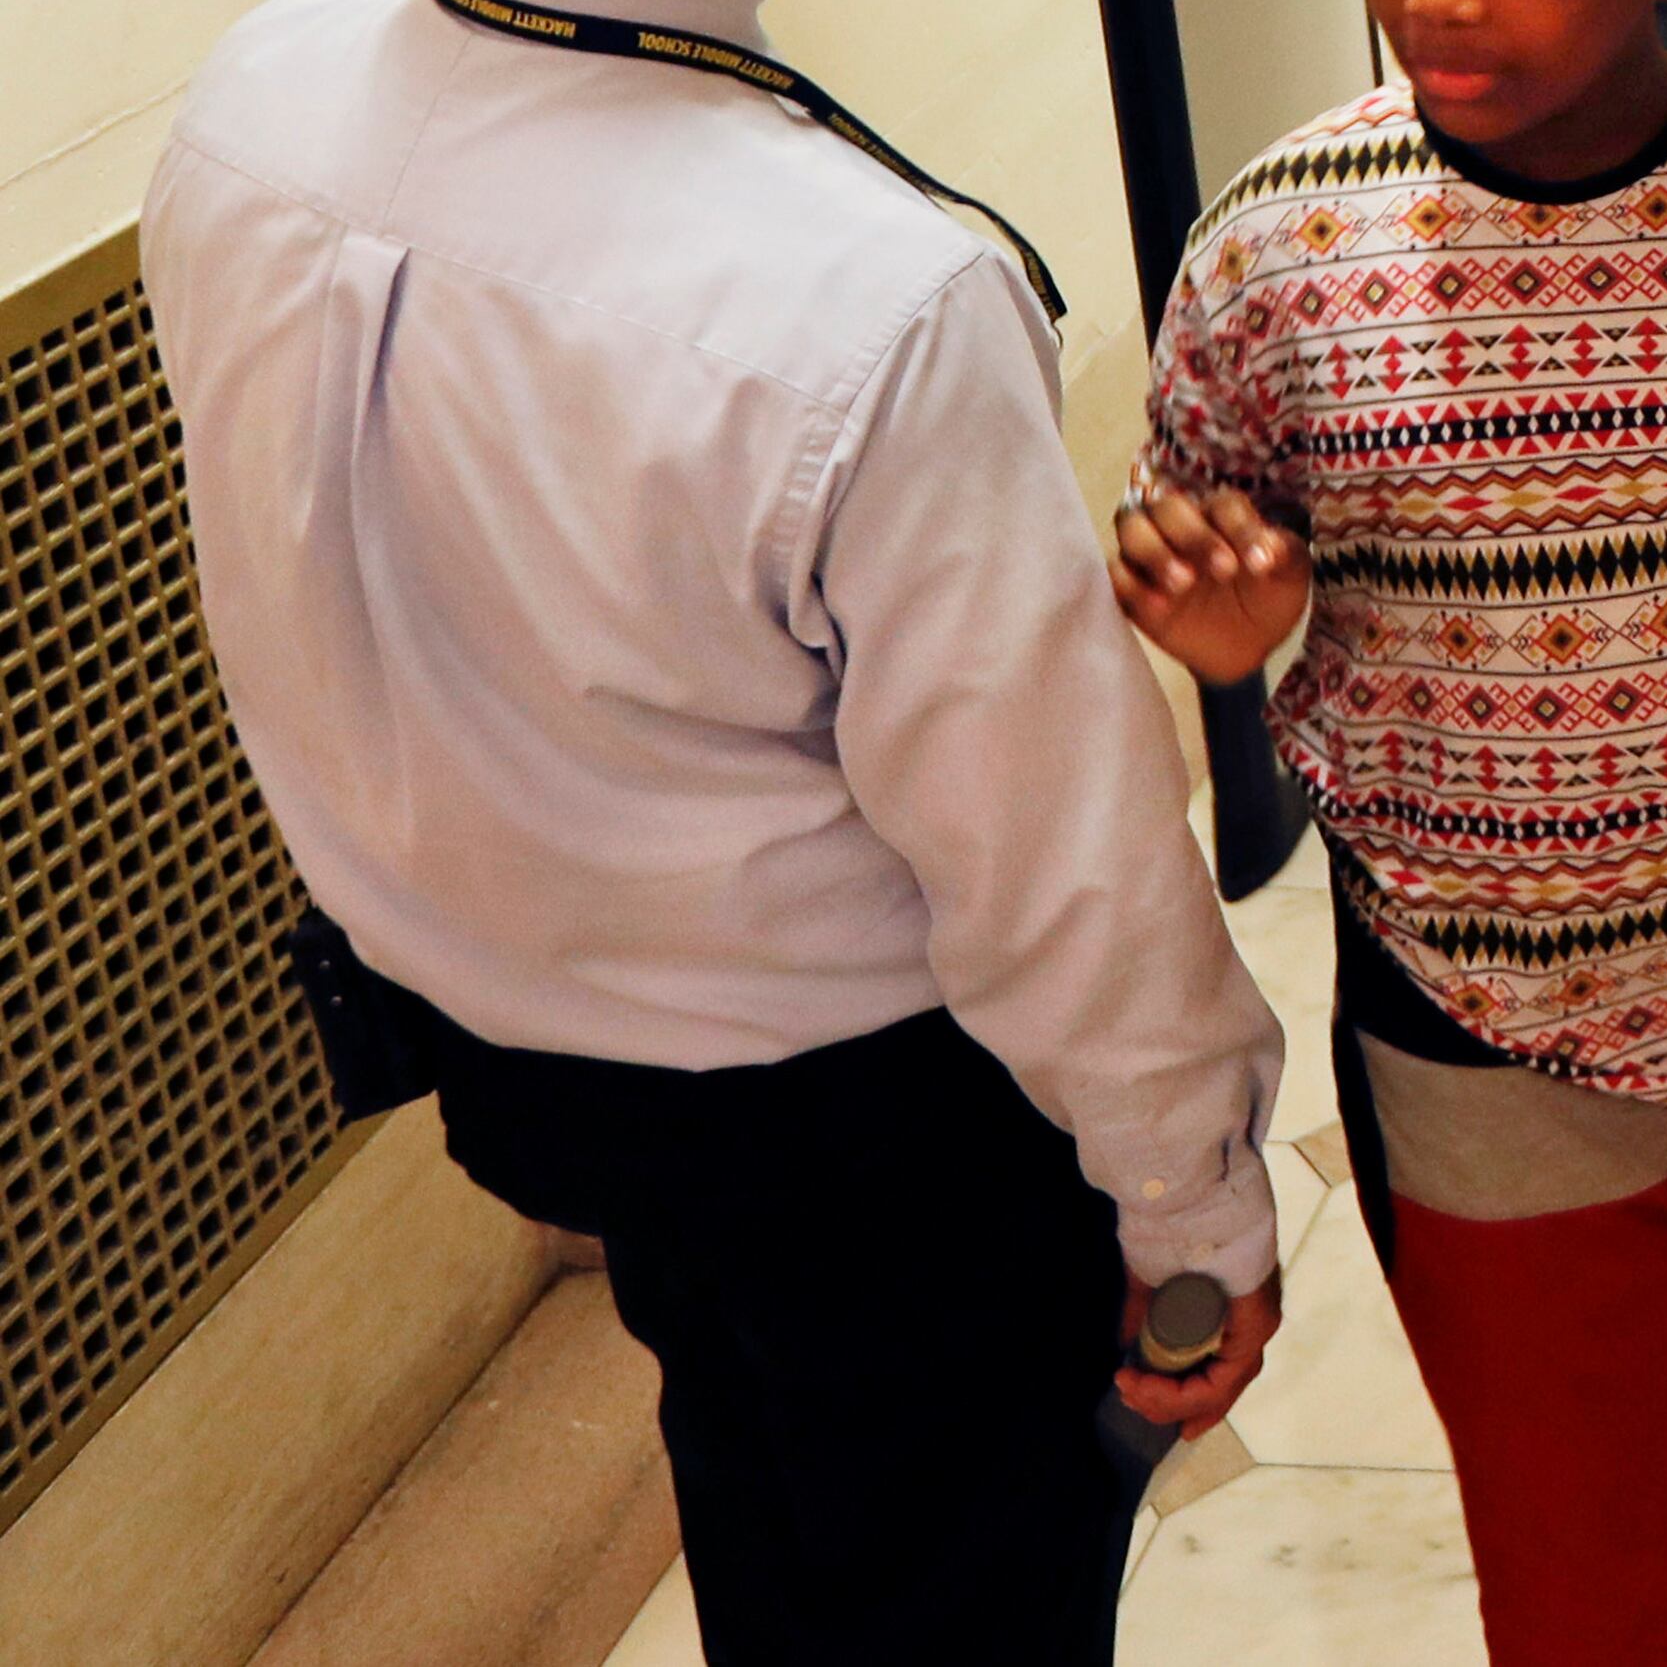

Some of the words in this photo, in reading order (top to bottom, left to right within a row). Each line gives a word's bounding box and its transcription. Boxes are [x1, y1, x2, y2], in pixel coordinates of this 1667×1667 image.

[513, 11, 577, 40] HACKETT
[638, 31, 694, 57] SCHOOL
[692, 43, 744, 69] MIDDLE
[739, 59, 795, 90] HACKETT
